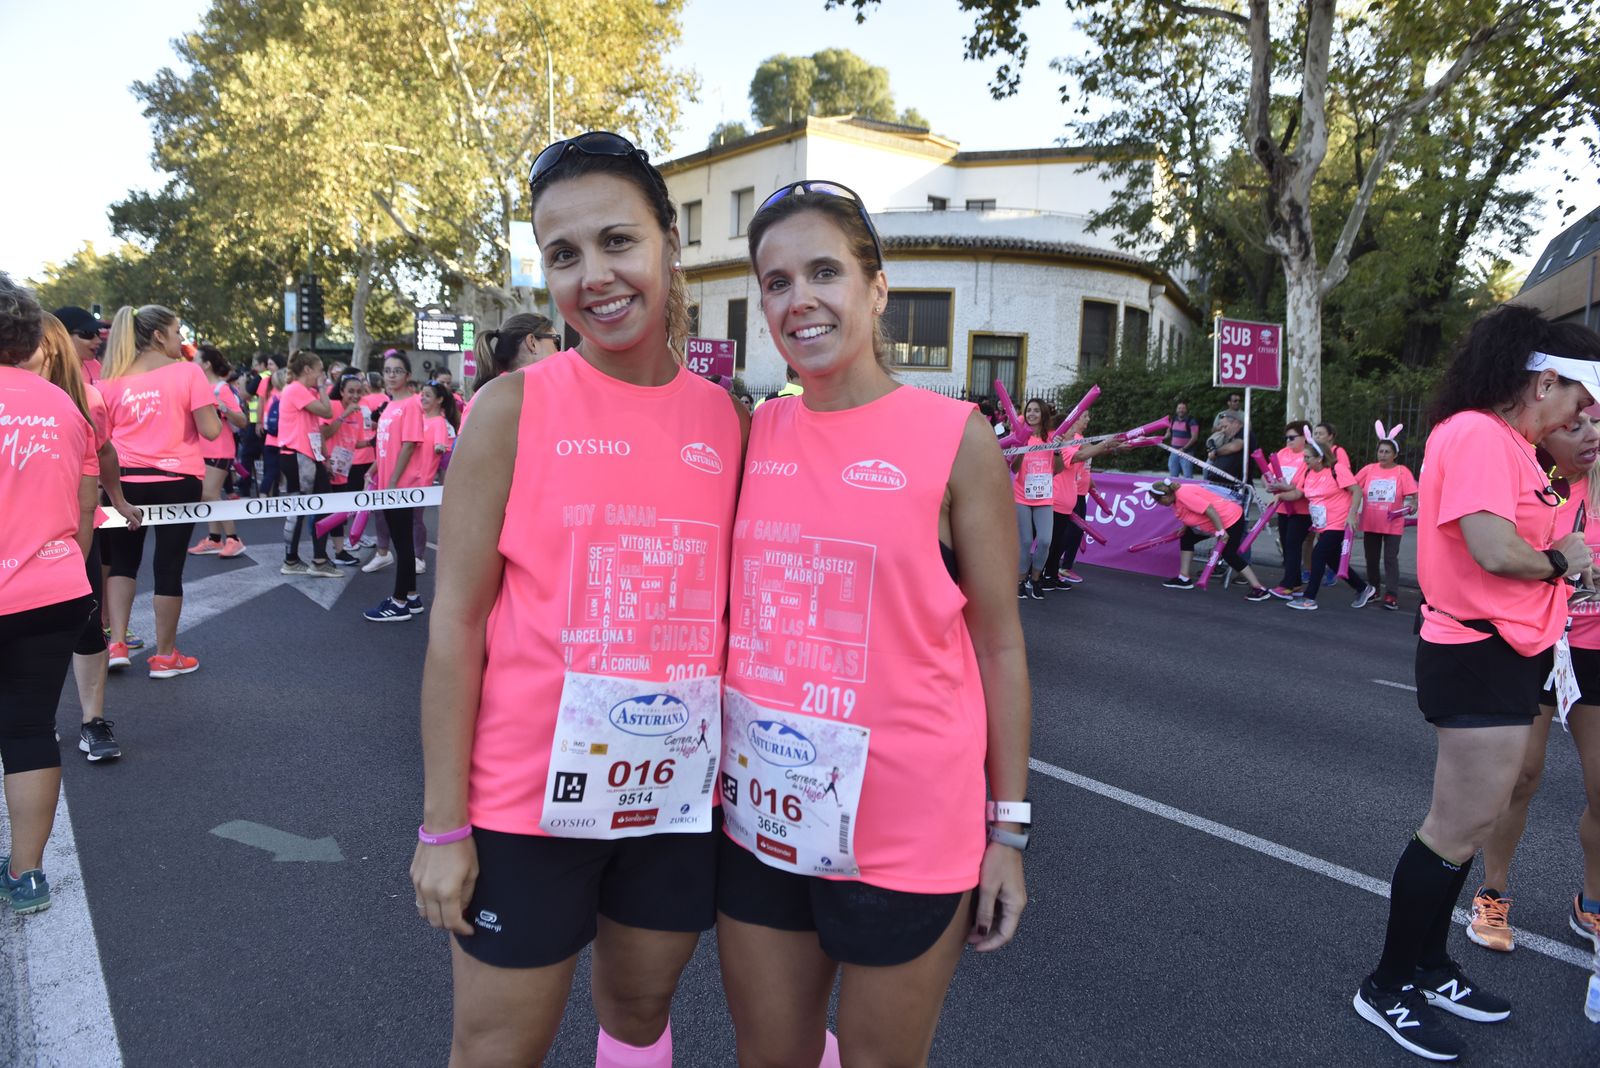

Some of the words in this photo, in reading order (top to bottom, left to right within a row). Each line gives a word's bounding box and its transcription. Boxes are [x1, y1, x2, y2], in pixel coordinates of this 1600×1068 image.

[1222, 325, 1251, 347] SUB
[690, 341, 713, 354] SUB
[556, 439, 631, 456] OYSHO
[846, 468, 901, 487] ASTURIANA
[563, 504, 596, 527] HOY
[605, 503, 657, 527] GANAN
[754, 520, 801, 544] GANAN
[620, 536, 663, 550] VITORIA
[672, 538, 707, 554] GASTEIZ
[643, 551, 684, 566] MADRID
[765, 551, 803, 568] VITORIA
[813, 556, 855, 574] GASTEIZ
[784, 569, 825, 585] MADRID
[645, 602, 666, 620] LAS
[561, 628, 624, 643] BARCELONA
[781, 618, 805, 636] LAS
[650, 624, 710, 651] CHICAS
[611, 656, 650, 672] CORUÑA
[784, 639, 859, 676] CHICAS
[755, 665, 785, 683] CORUÑA
[801, 681, 857, 719] 2019
[615, 707, 685, 726] ASTURIANA
[750, 728, 809, 762] ASTURIANA
[607, 758, 677, 788] 016
[618, 791, 653, 806] 9514
[749, 777, 802, 823] 016
[550, 817, 596, 828] OYSHO
[670, 816, 698, 824] ZURICH
[757, 815, 787, 838] 3656
